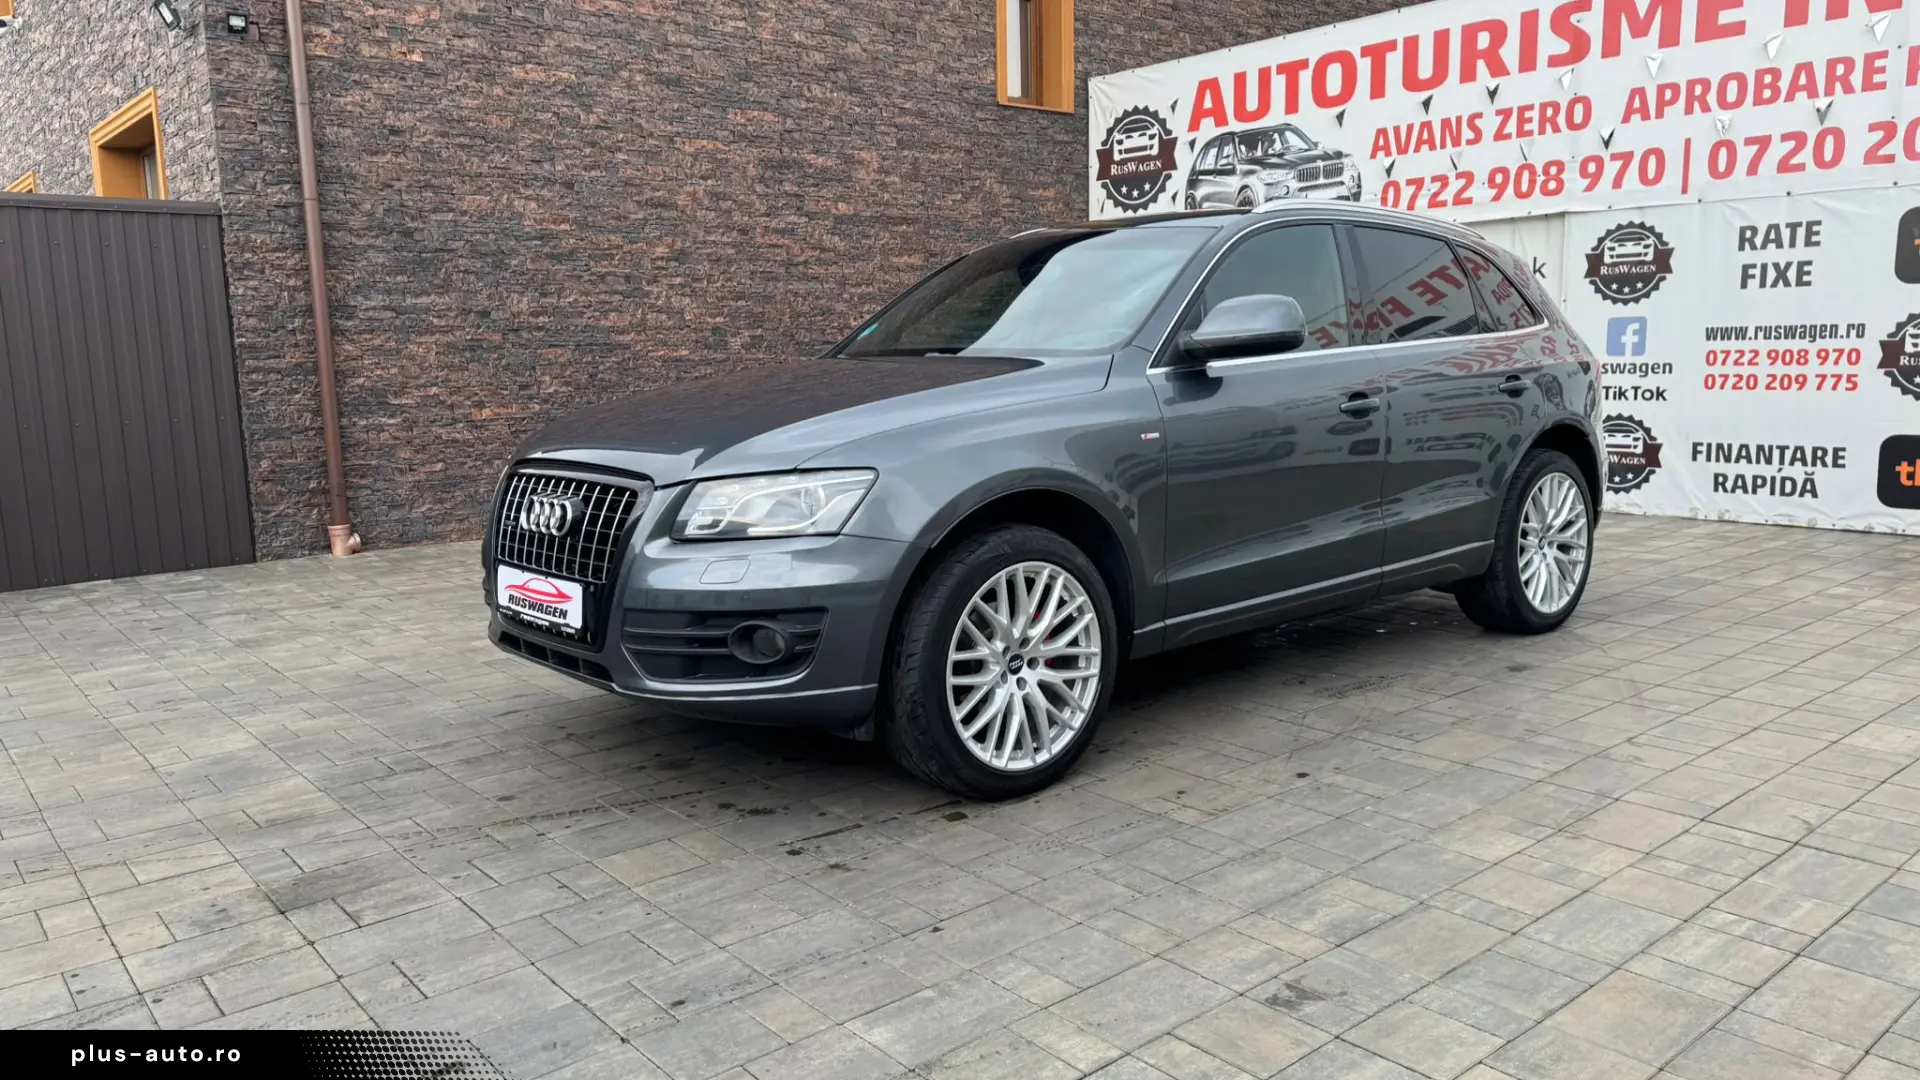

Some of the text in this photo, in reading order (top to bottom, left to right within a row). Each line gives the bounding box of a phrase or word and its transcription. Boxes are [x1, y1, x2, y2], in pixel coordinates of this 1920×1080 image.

[1187, 0, 1746, 132] AUTOTURISME
[1370, 112, 1483, 160] AVANS
[1493, 96, 1592, 142] ZERO
[1621, 50, 1889, 124] APROBARE
[1380, 172, 1474, 210] 0722
[1487, 159, 1565, 202] 908
[1578, 147, 1666, 192] 970
[1708, 126, 1845, 180] 0720
[1738, 220, 1822, 251] RATE
[1740, 260, 1813, 289] FIXE
[1705, 323, 1866, 343] www.ruswagen.ro
[1705, 348, 1861, 366] 0722 908 970
[1602, 386, 1668, 401] TikTok
[1704, 373, 1859, 391] 0720 209 775
[508, 594, 568, 620] RUSWAGEN
